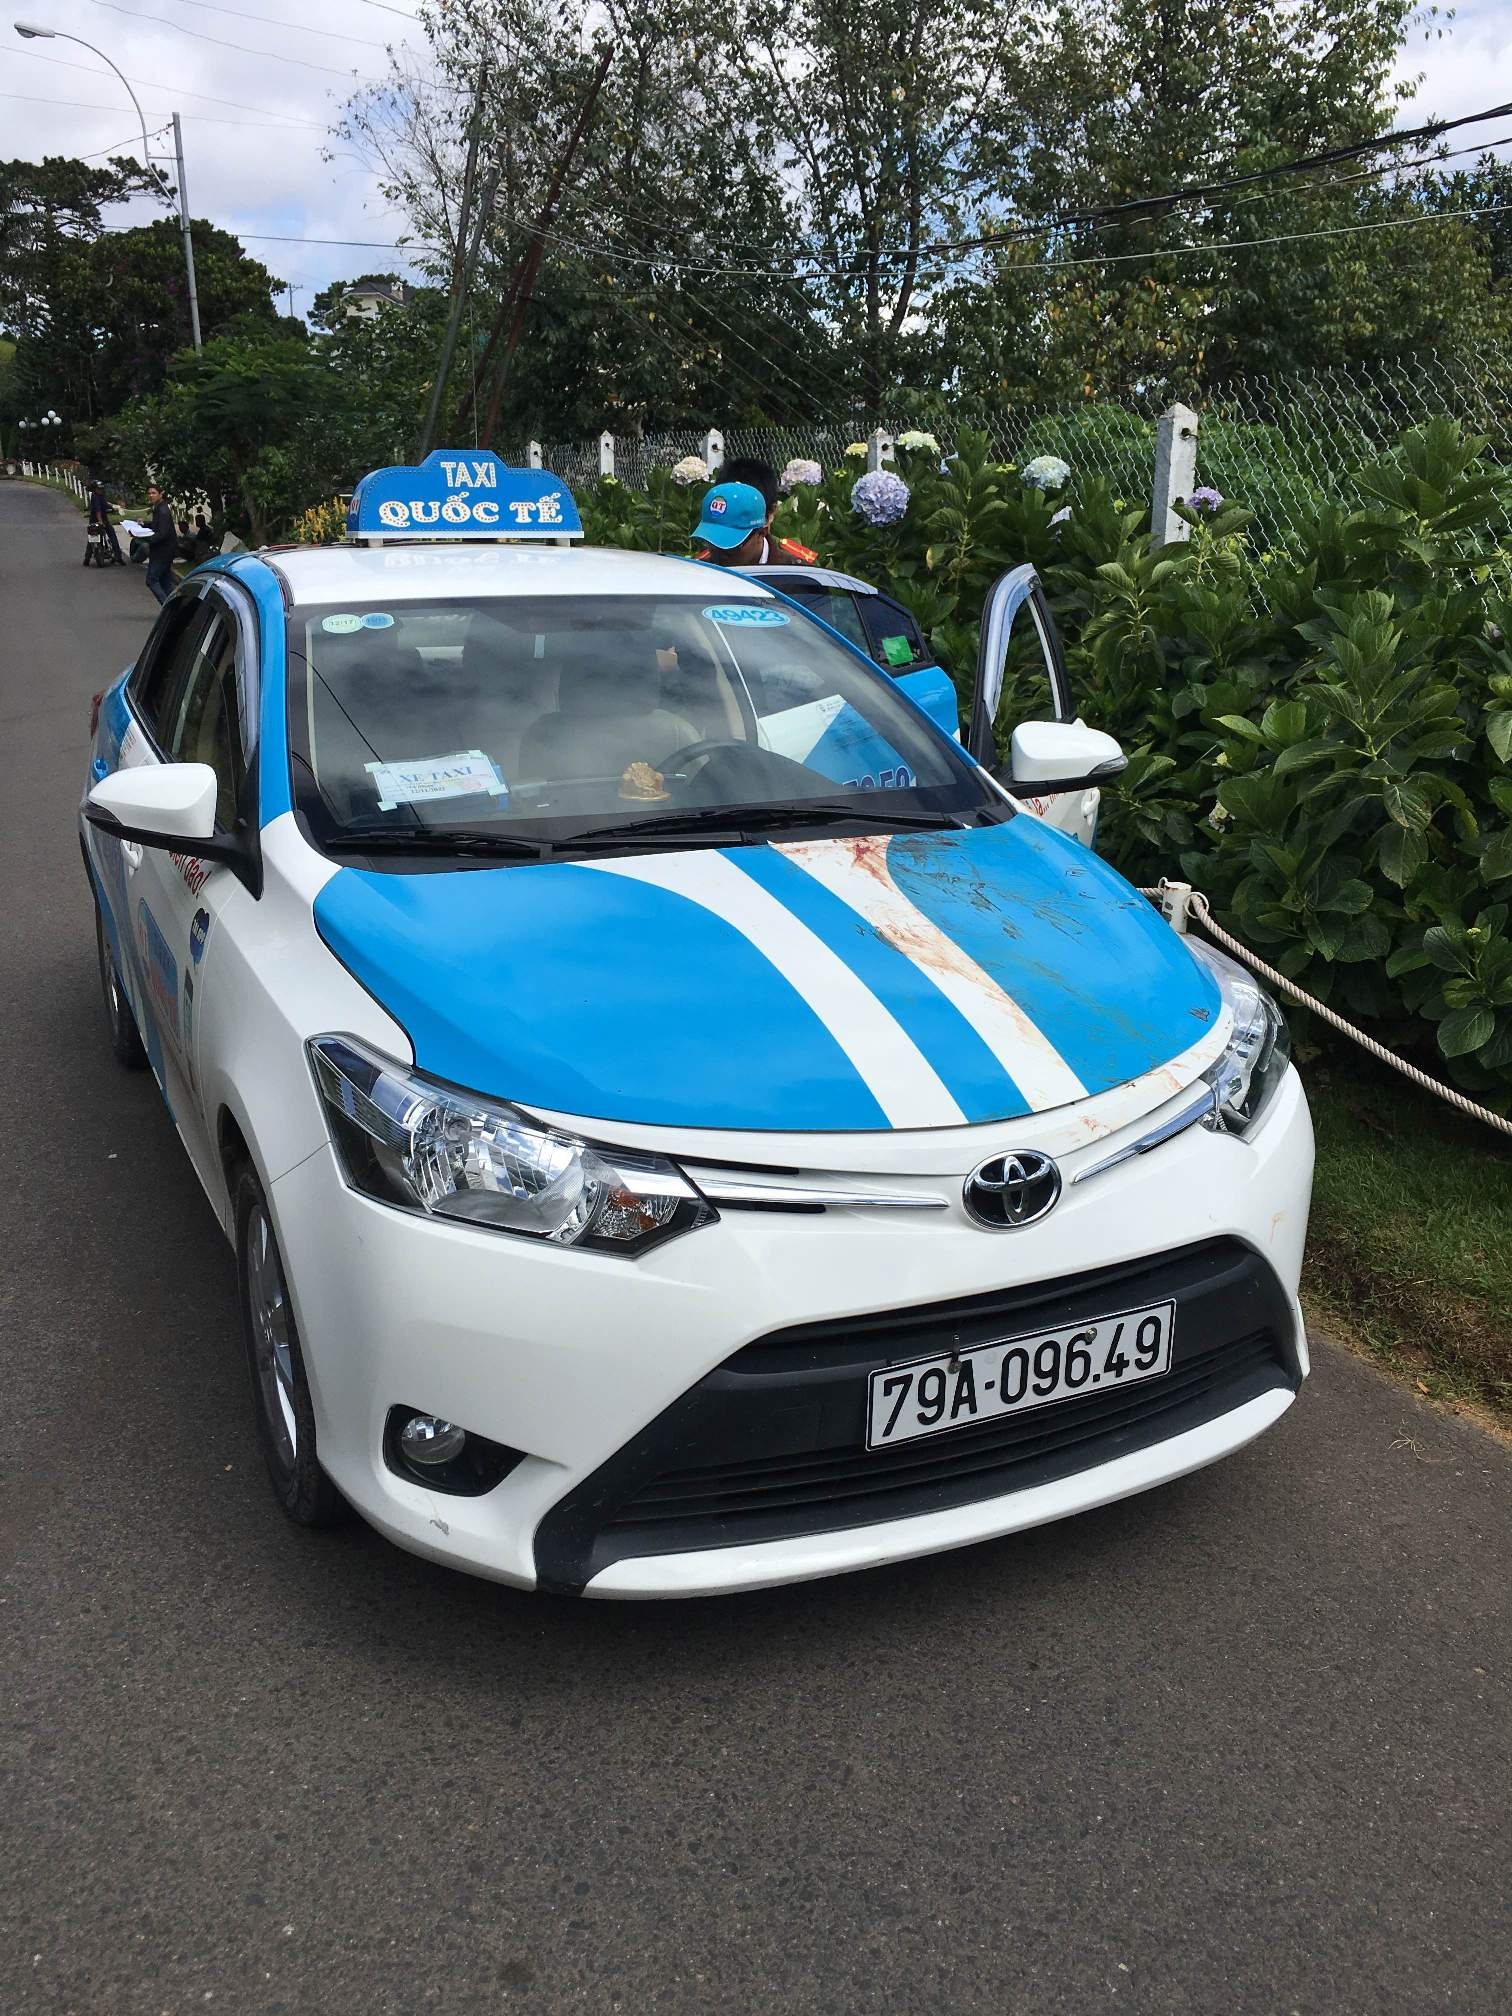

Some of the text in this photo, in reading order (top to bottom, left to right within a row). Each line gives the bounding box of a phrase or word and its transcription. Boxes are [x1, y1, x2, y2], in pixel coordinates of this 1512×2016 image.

[440, 461, 497, 488] TAXI
[378, 491, 563, 527] QUỐC TẾ
[711, 609, 786, 622] 49423
[430, 765, 473, 781] TAXI
[881, 1315, 1162, 1438] 79A-096.49
